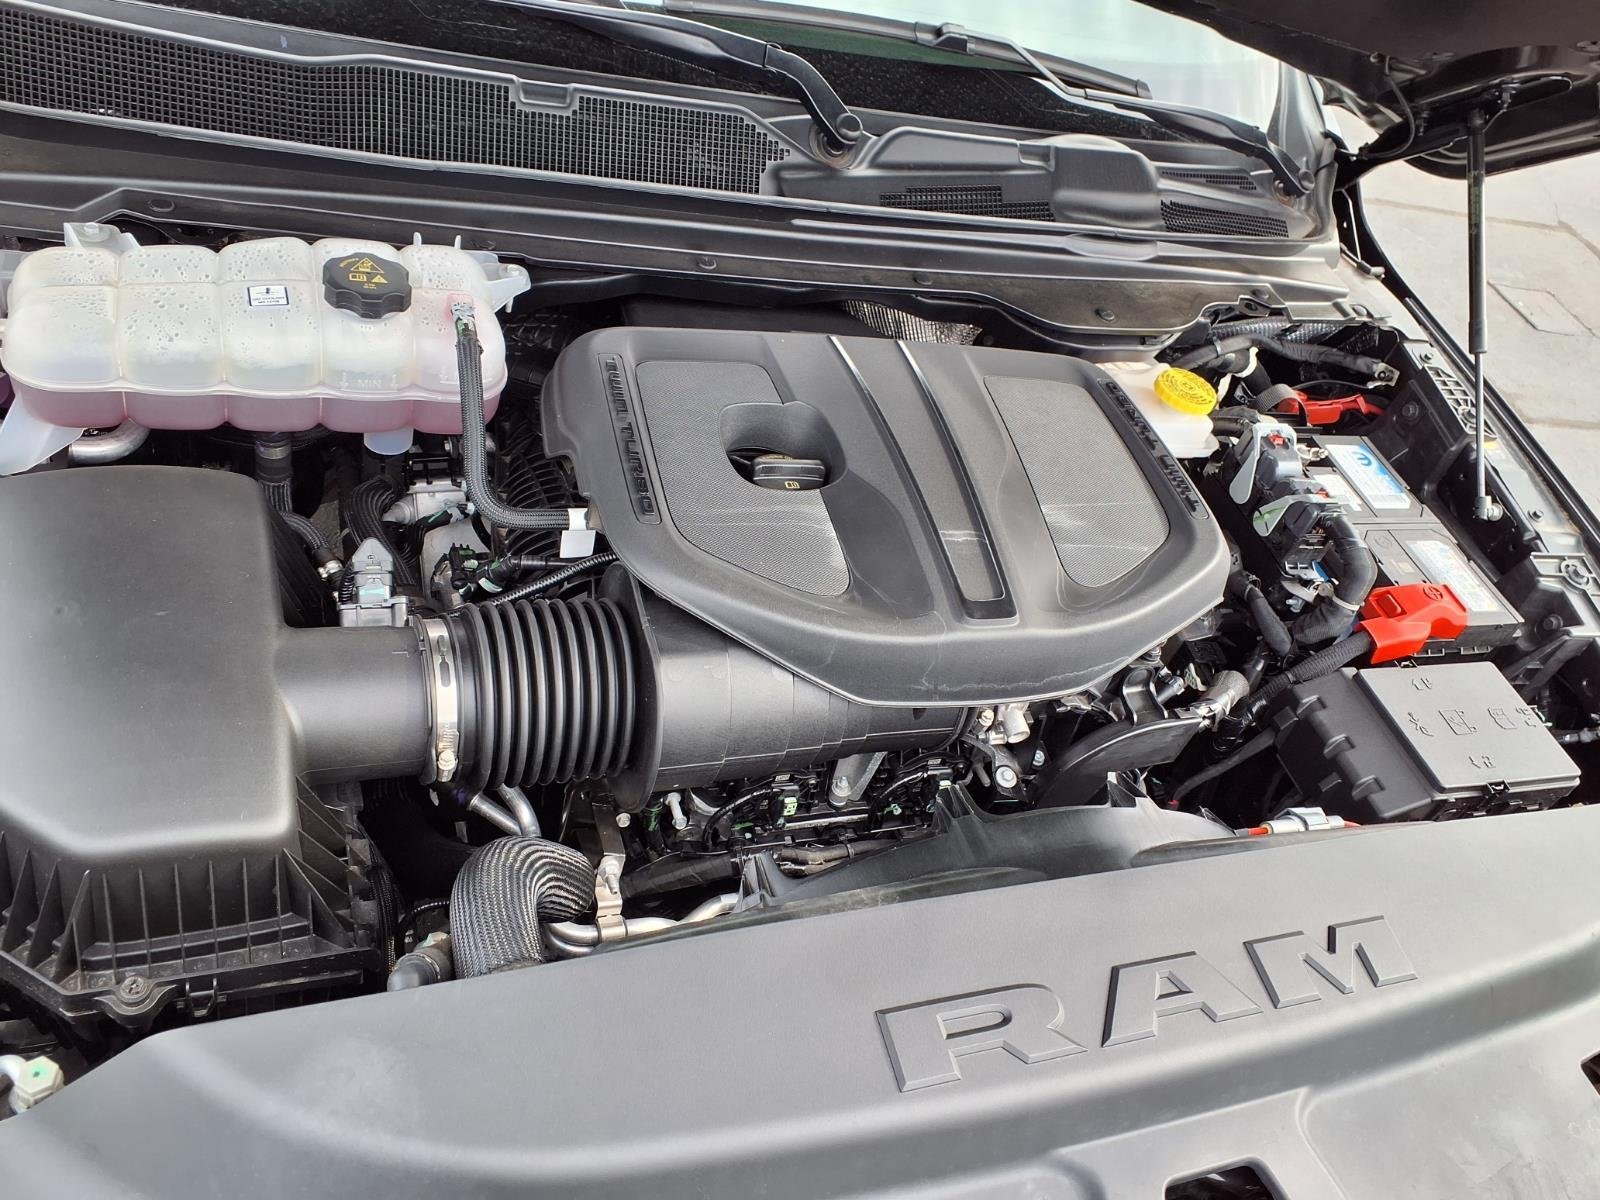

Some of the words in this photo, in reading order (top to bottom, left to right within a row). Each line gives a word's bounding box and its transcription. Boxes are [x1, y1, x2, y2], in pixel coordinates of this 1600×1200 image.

[357, 378, 382, 390] MIN
[606, 356, 629, 416] TWIN
[621, 421, 655, 516] TURBO
[873, 914, 1419, 1093] RAM
